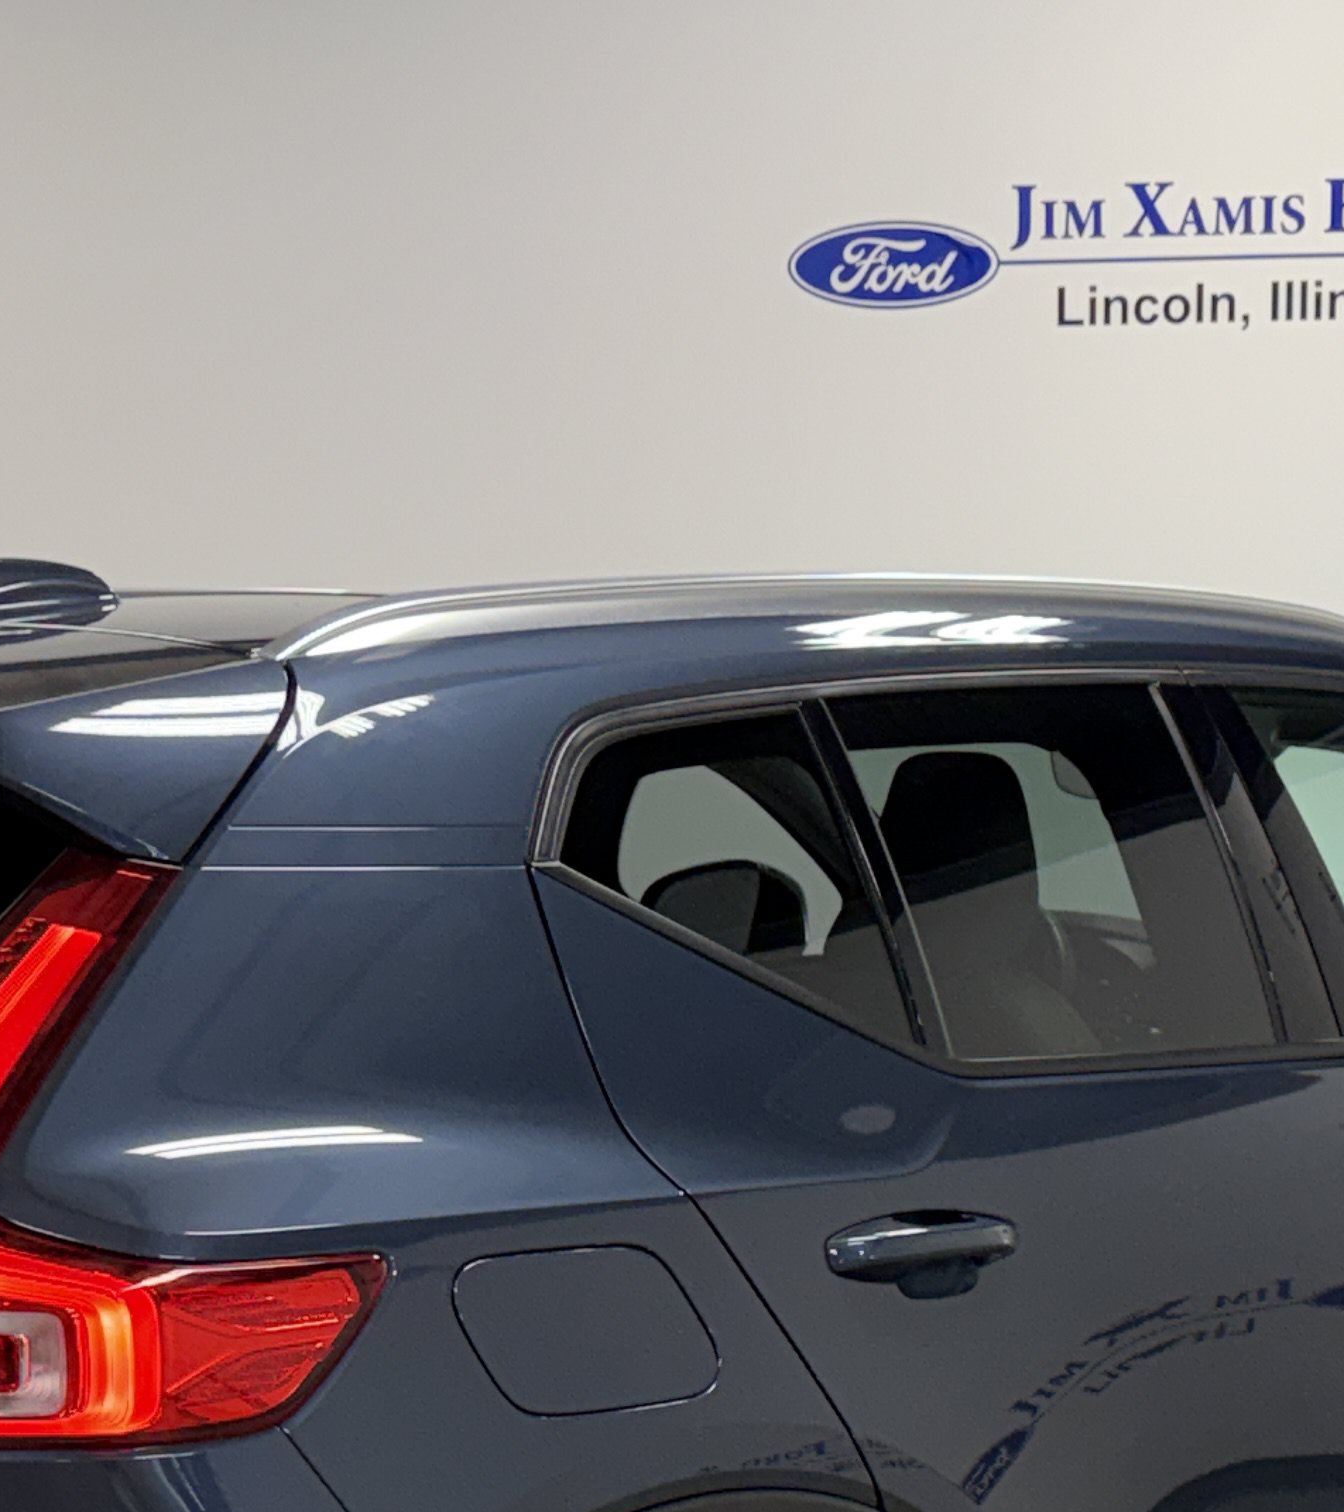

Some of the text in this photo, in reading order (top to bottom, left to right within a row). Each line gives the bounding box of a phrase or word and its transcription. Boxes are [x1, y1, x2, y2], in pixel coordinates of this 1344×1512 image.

[1010, 184, 1106, 251] JIM
[1123, 180, 1307, 239] XAMIS
[829, 236, 958, 294] Ford
[1057, 282, 1251, 332] Lincoln,
